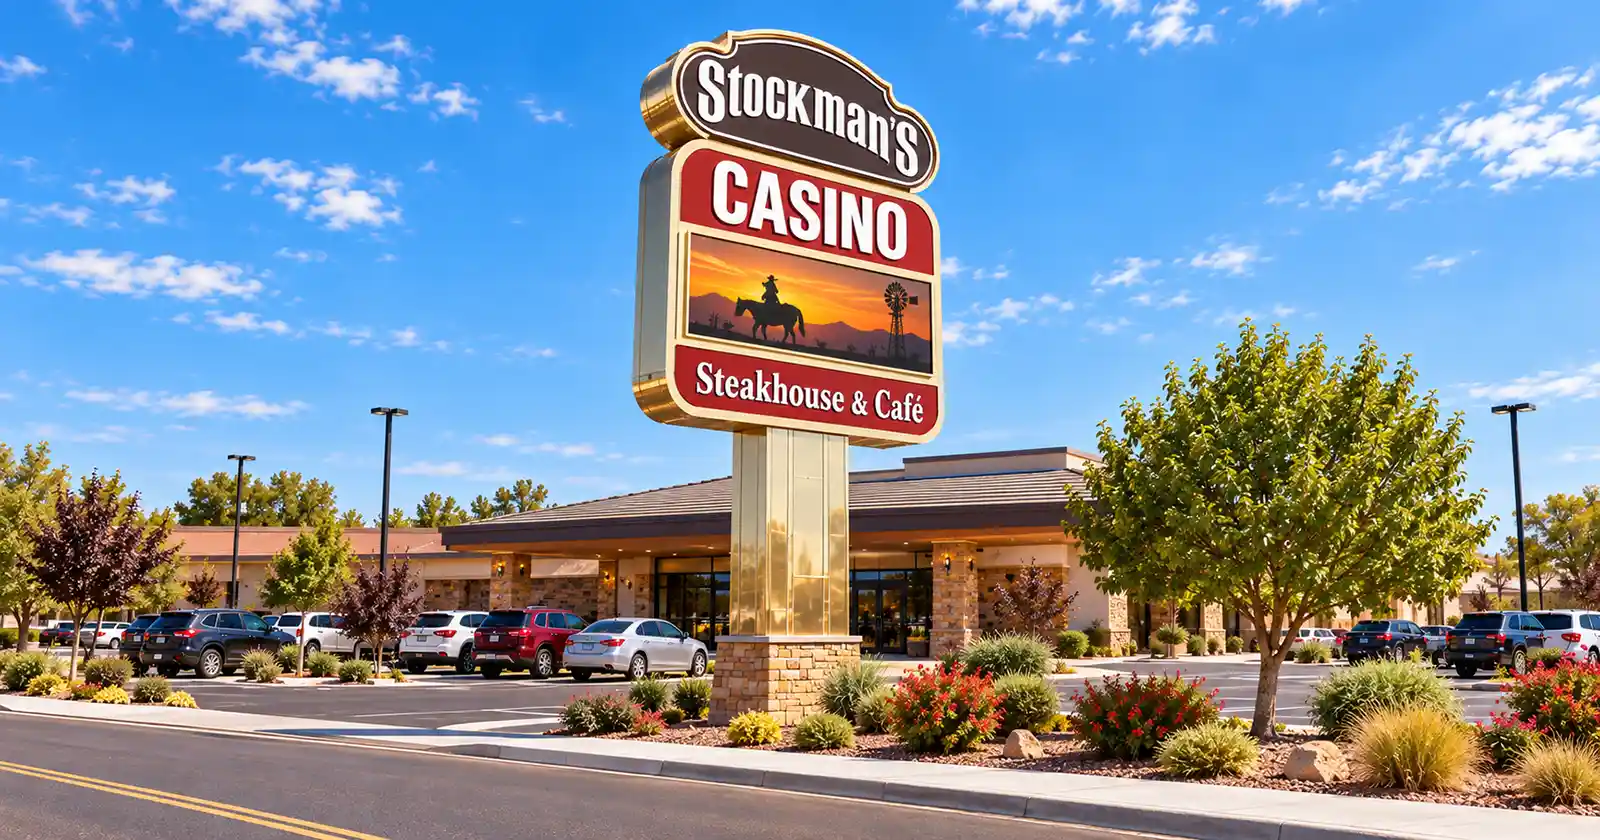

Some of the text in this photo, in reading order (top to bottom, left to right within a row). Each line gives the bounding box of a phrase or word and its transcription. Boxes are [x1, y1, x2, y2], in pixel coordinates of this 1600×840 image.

[713, 160, 908, 260] CASINO
[696, 361, 924, 423] Steakhouse & Café
